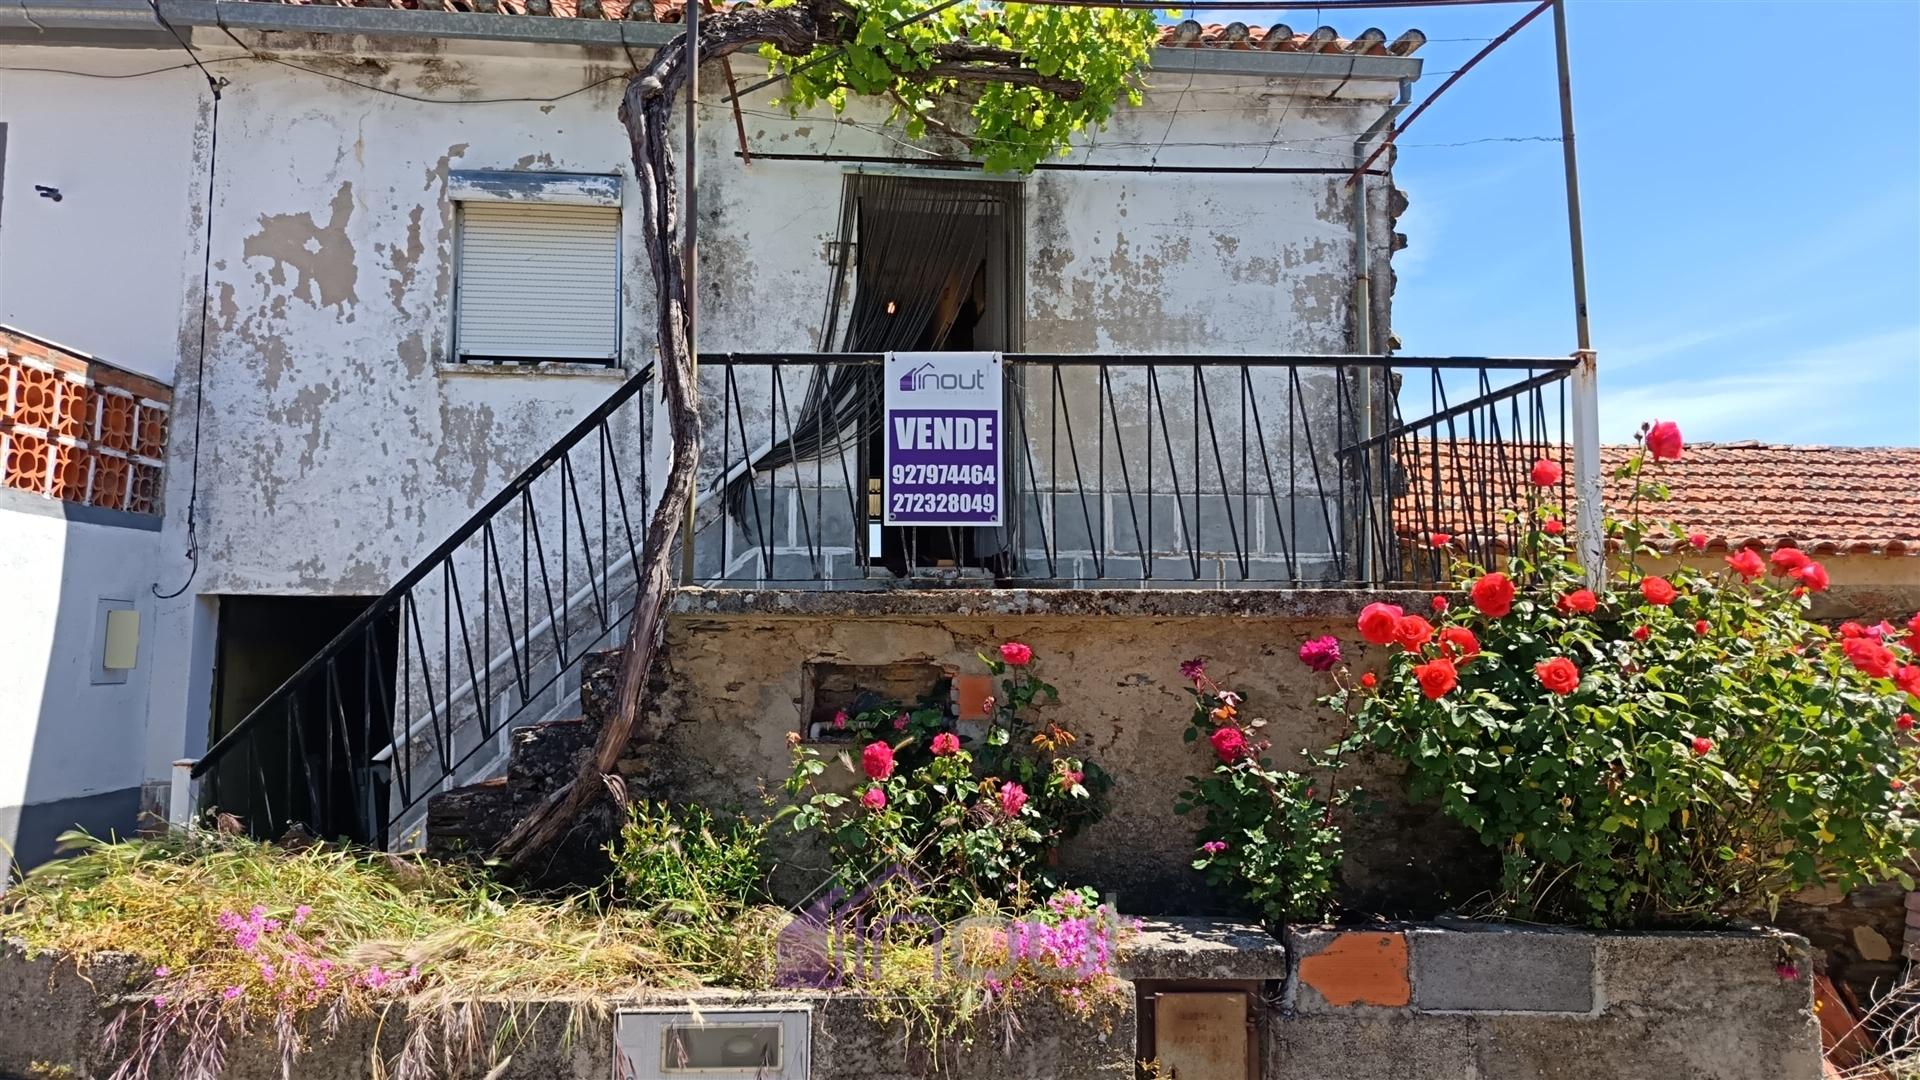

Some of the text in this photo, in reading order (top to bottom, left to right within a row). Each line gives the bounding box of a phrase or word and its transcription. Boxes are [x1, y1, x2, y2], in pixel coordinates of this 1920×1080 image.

[918, 368, 984, 390] inout
[894, 416, 993, 450] VENDE
[892, 464, 995, 484] 927974464
[893, 493, 995, 513] 272328049
